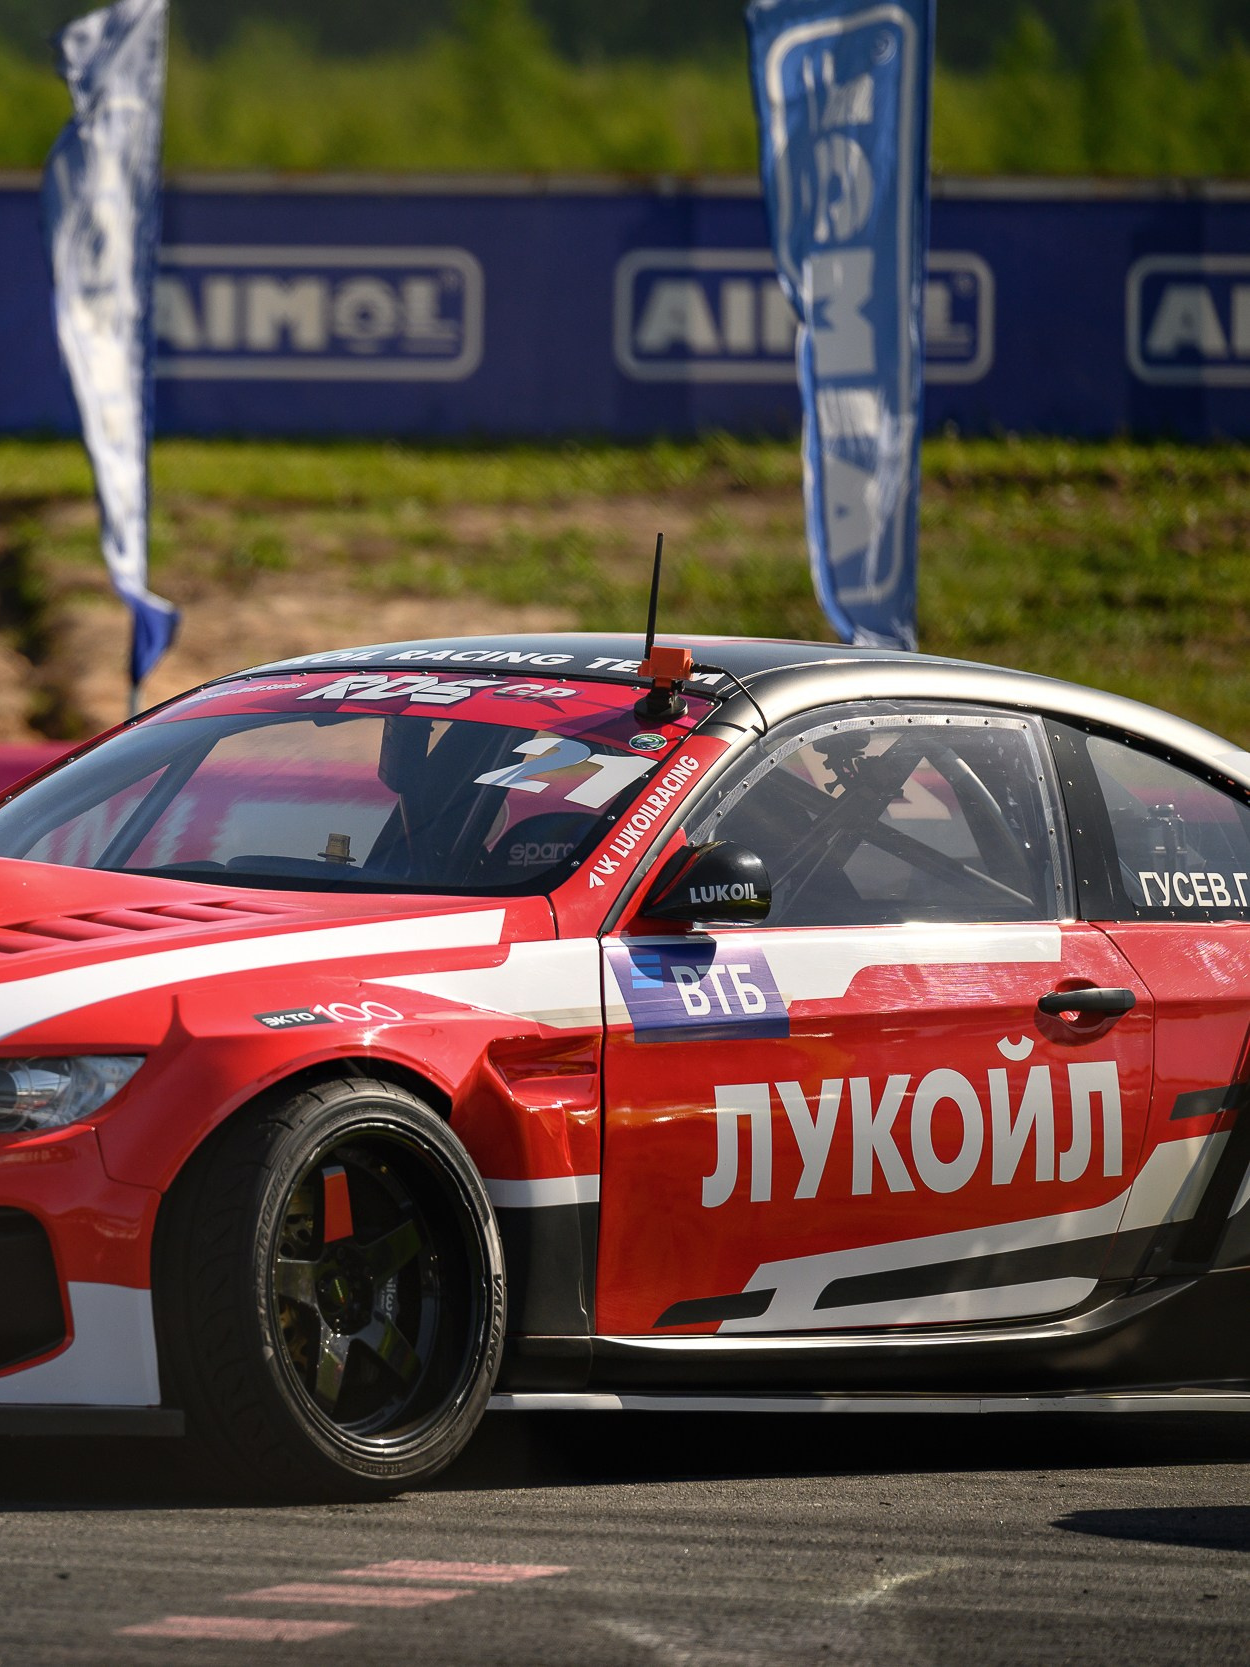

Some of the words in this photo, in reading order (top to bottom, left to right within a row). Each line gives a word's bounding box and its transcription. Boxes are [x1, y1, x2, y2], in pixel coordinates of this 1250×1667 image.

[634, 281, 970, 354] AIL
[296, 674, 509, 704] RDS
[492, 684, 578, 701] GP
[385, 648, 575, 666] RACING
[585, 656, 726, 686] TEM
[473, 737, 659, 809] 21
[610, 754, 700, 859] LUKOILRACING
[689, 882, 758, 905] LUKOIL
[261, 1012, 316, 1027] ЭКТО
[313, 1001, 404, 1023] 100
[669, 963, 768, 1016] ВТБ
[701, 1034, 1123, 1208] ЛУКОЙЛ
[485, 1273, 504, 1379] VALINO
